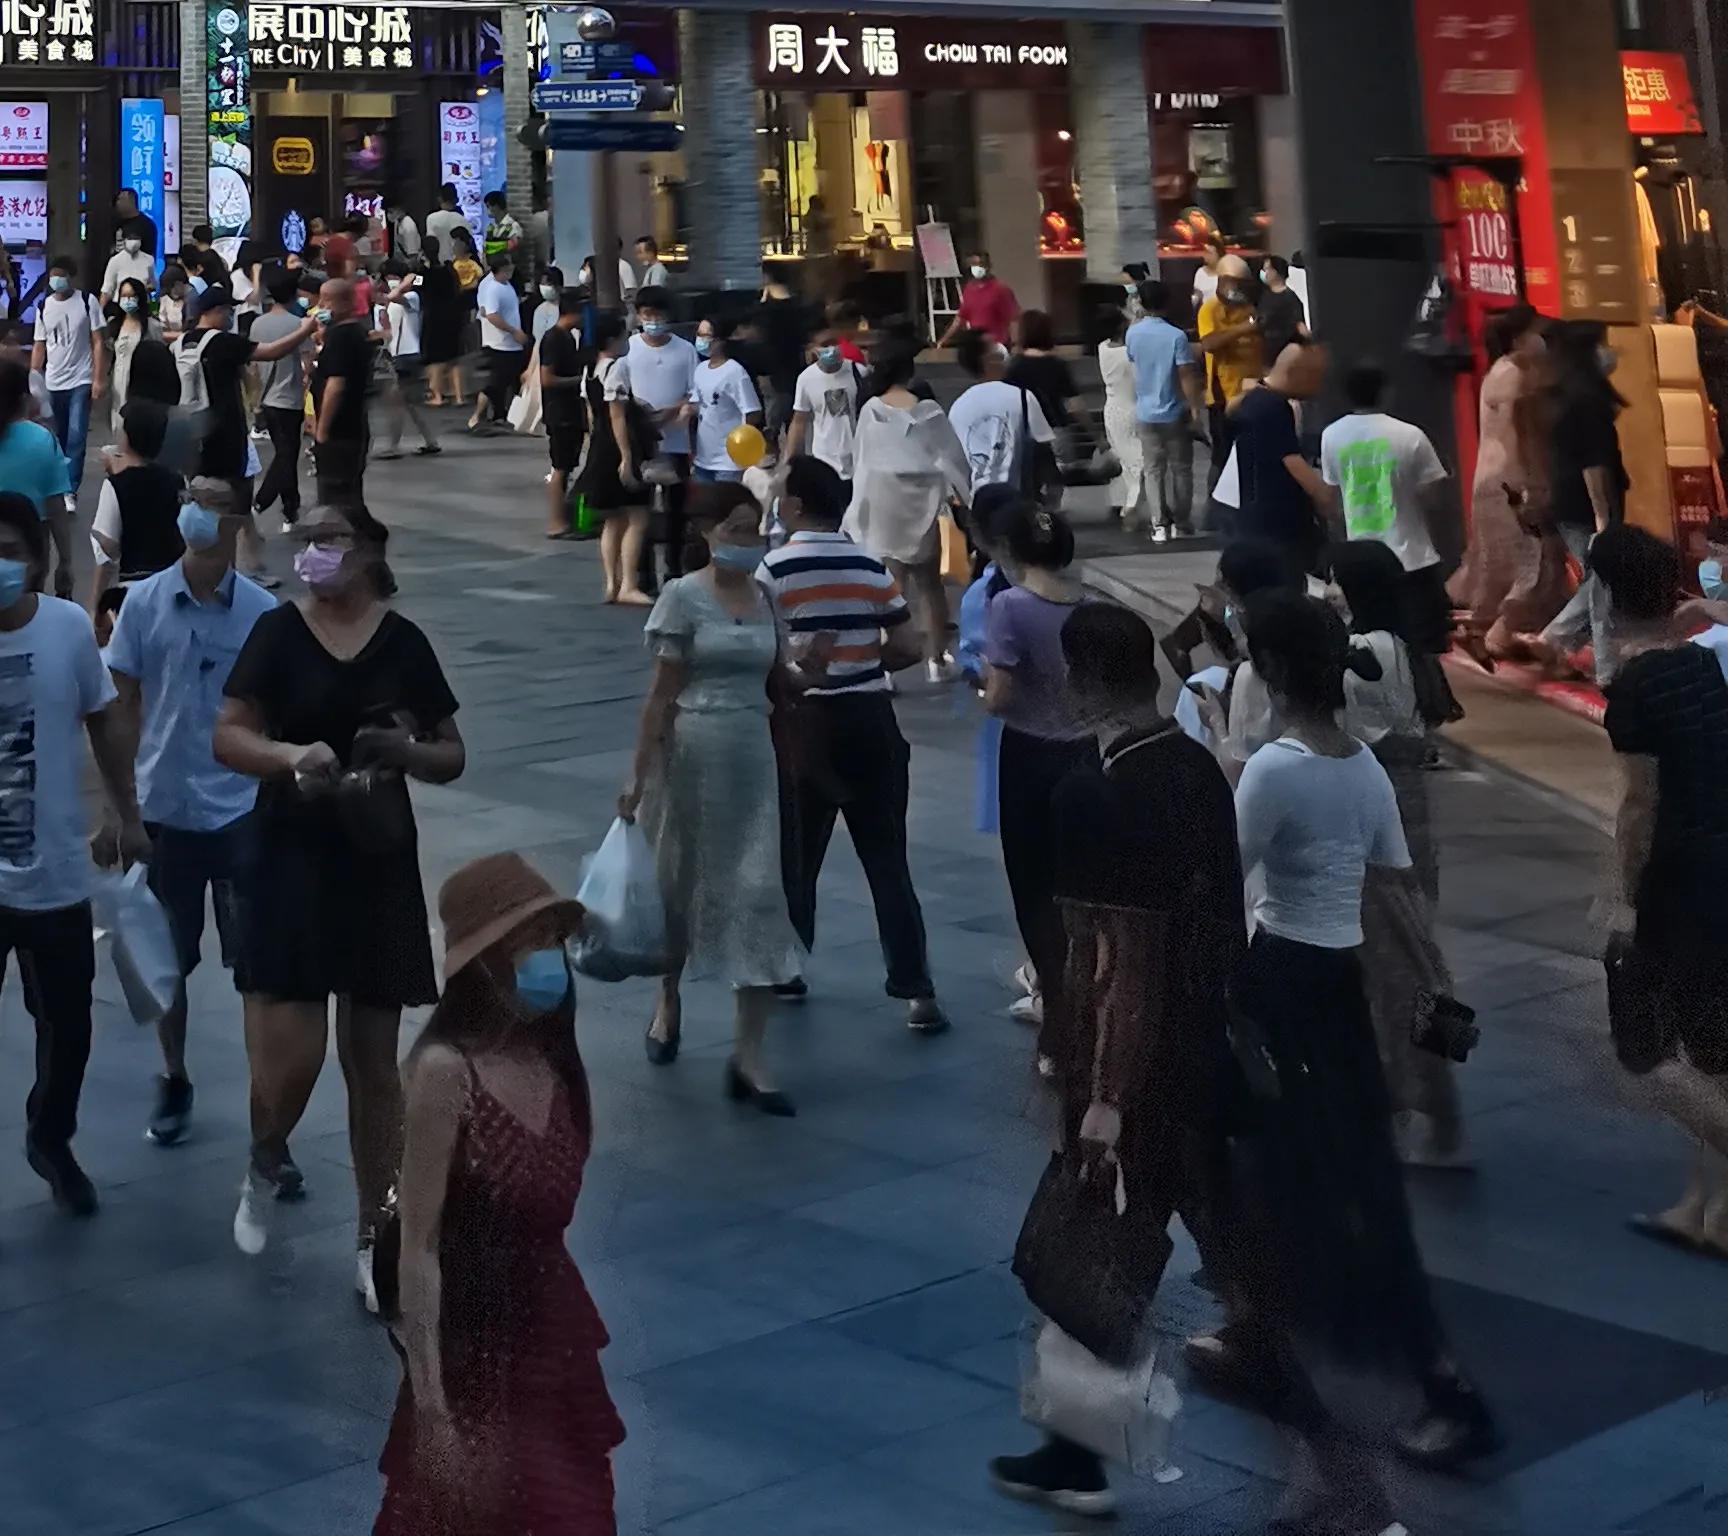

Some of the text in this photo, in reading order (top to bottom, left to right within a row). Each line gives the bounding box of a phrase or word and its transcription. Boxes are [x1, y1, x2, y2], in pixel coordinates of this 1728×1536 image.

[17, 38, 95, 62] 美食城
[342, 45, 413, 69] 美食城
[767, 24, 900, 77] 周大福
[925, 43, 1069, 66] CHOW TAI FOOK
[1448, 118, 1525, 154] 中秋
